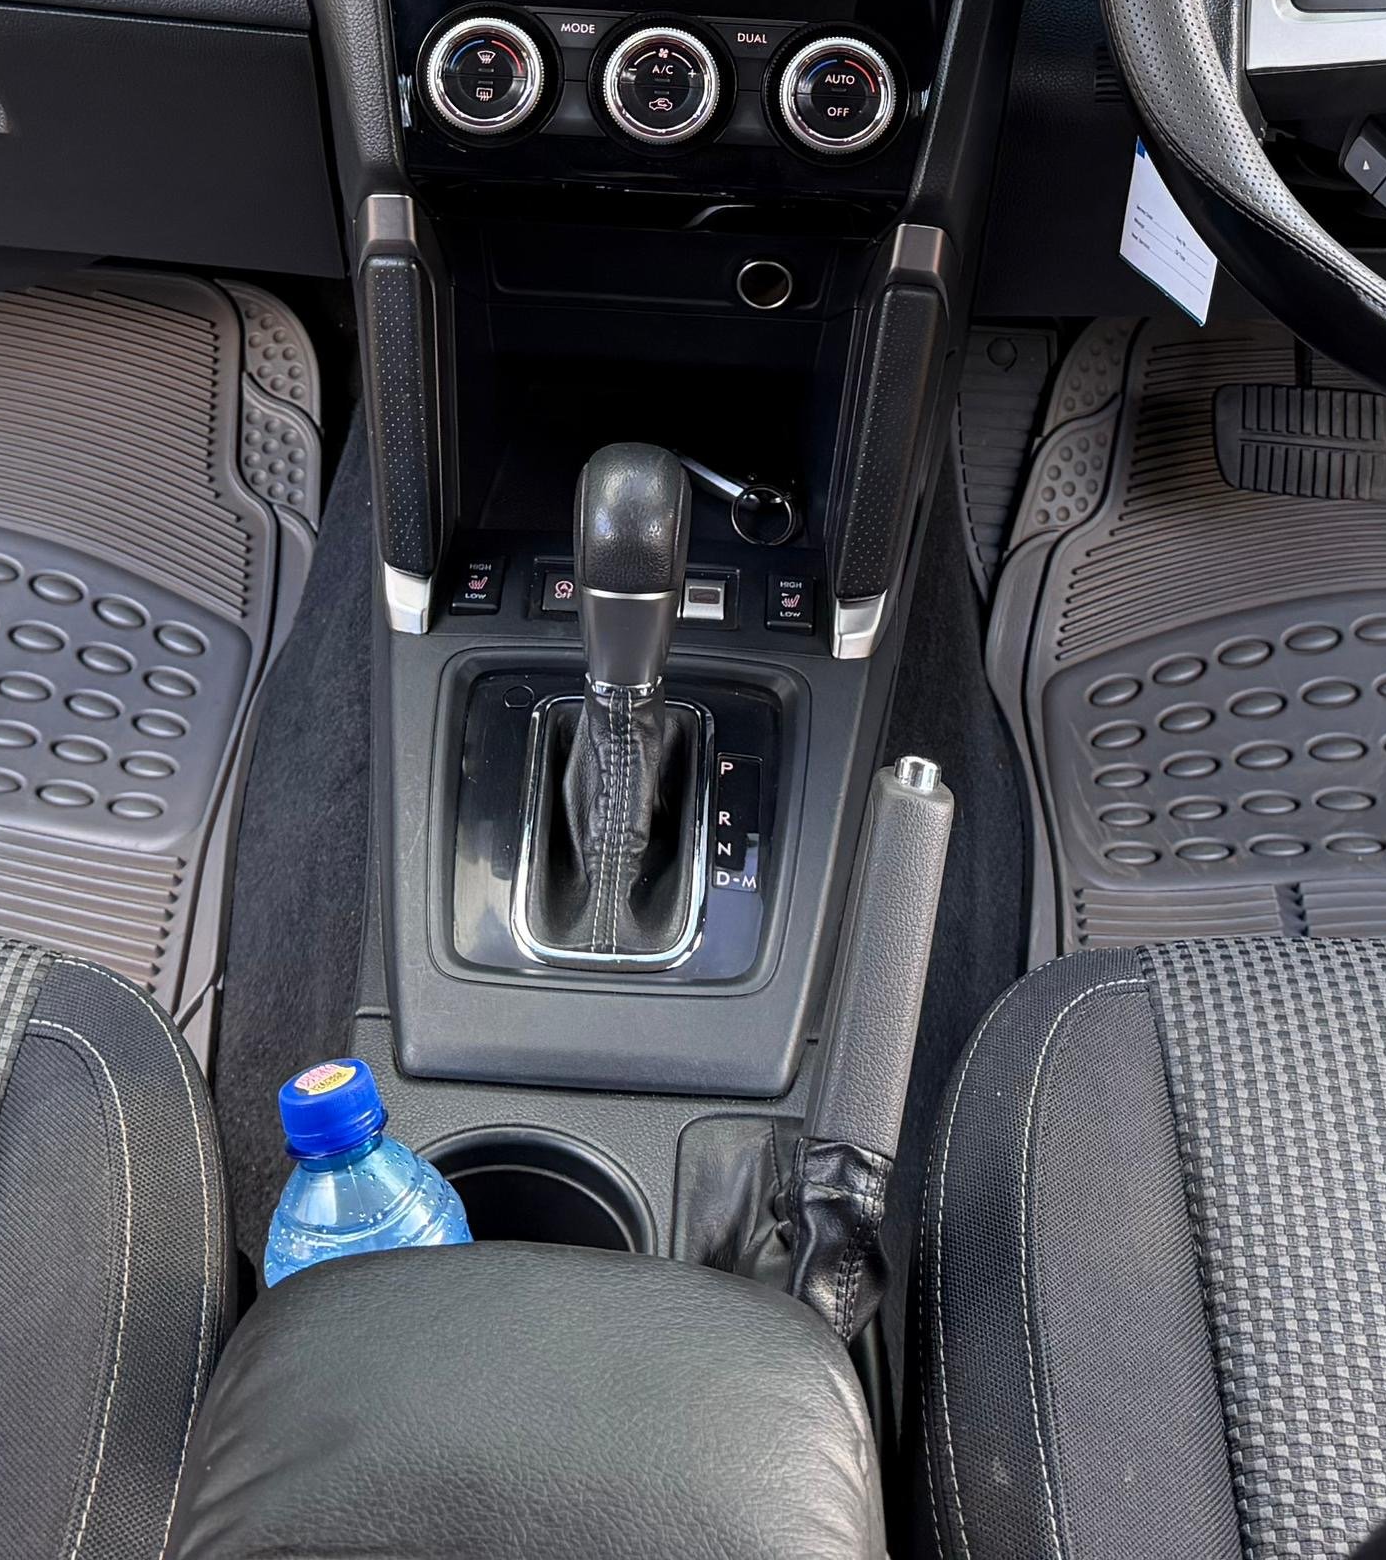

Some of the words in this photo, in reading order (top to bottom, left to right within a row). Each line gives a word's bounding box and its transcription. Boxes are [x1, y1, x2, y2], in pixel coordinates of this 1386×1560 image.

[560, 22, 596, 35] MODE
[737, 32, 768, 44] DUAL
[652, 64, 674, 75] A/C
[824, 74, 855, 85] AUTO
[827, 106, 850, 117] OFF
[469, 563, 492, 571] HIGH
[780, 581, 802, 589] HIGH
[720, 762, 733, 775] P
[718, 811, 731, 826] R
[717, 842, 731, 856] N
